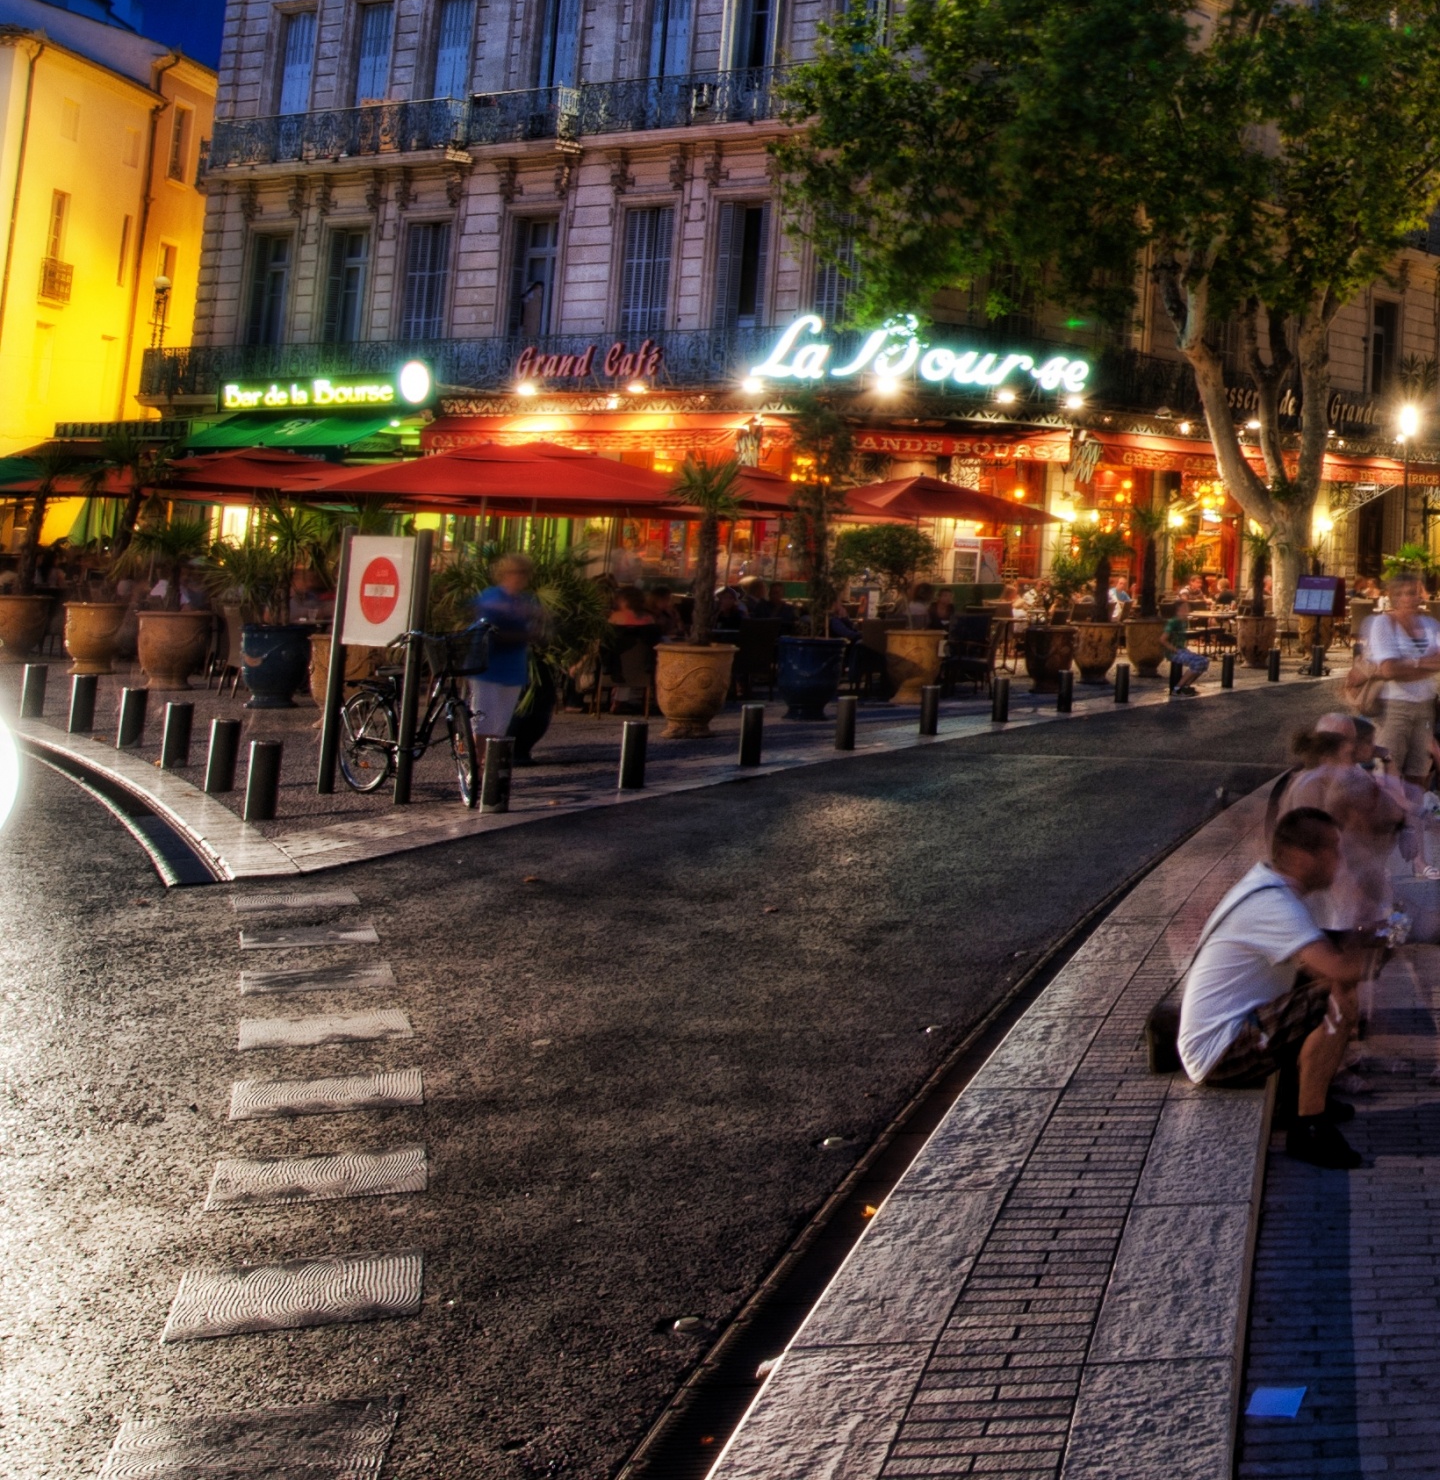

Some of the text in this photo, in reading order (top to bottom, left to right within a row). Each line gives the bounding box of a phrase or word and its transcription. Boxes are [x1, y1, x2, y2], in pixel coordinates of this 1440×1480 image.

[515, 338, 662, 381] Grand Café
[750, 313, 1090, 392] La Bourse
[224, 379, 394, 407] Bar de la Bourse
